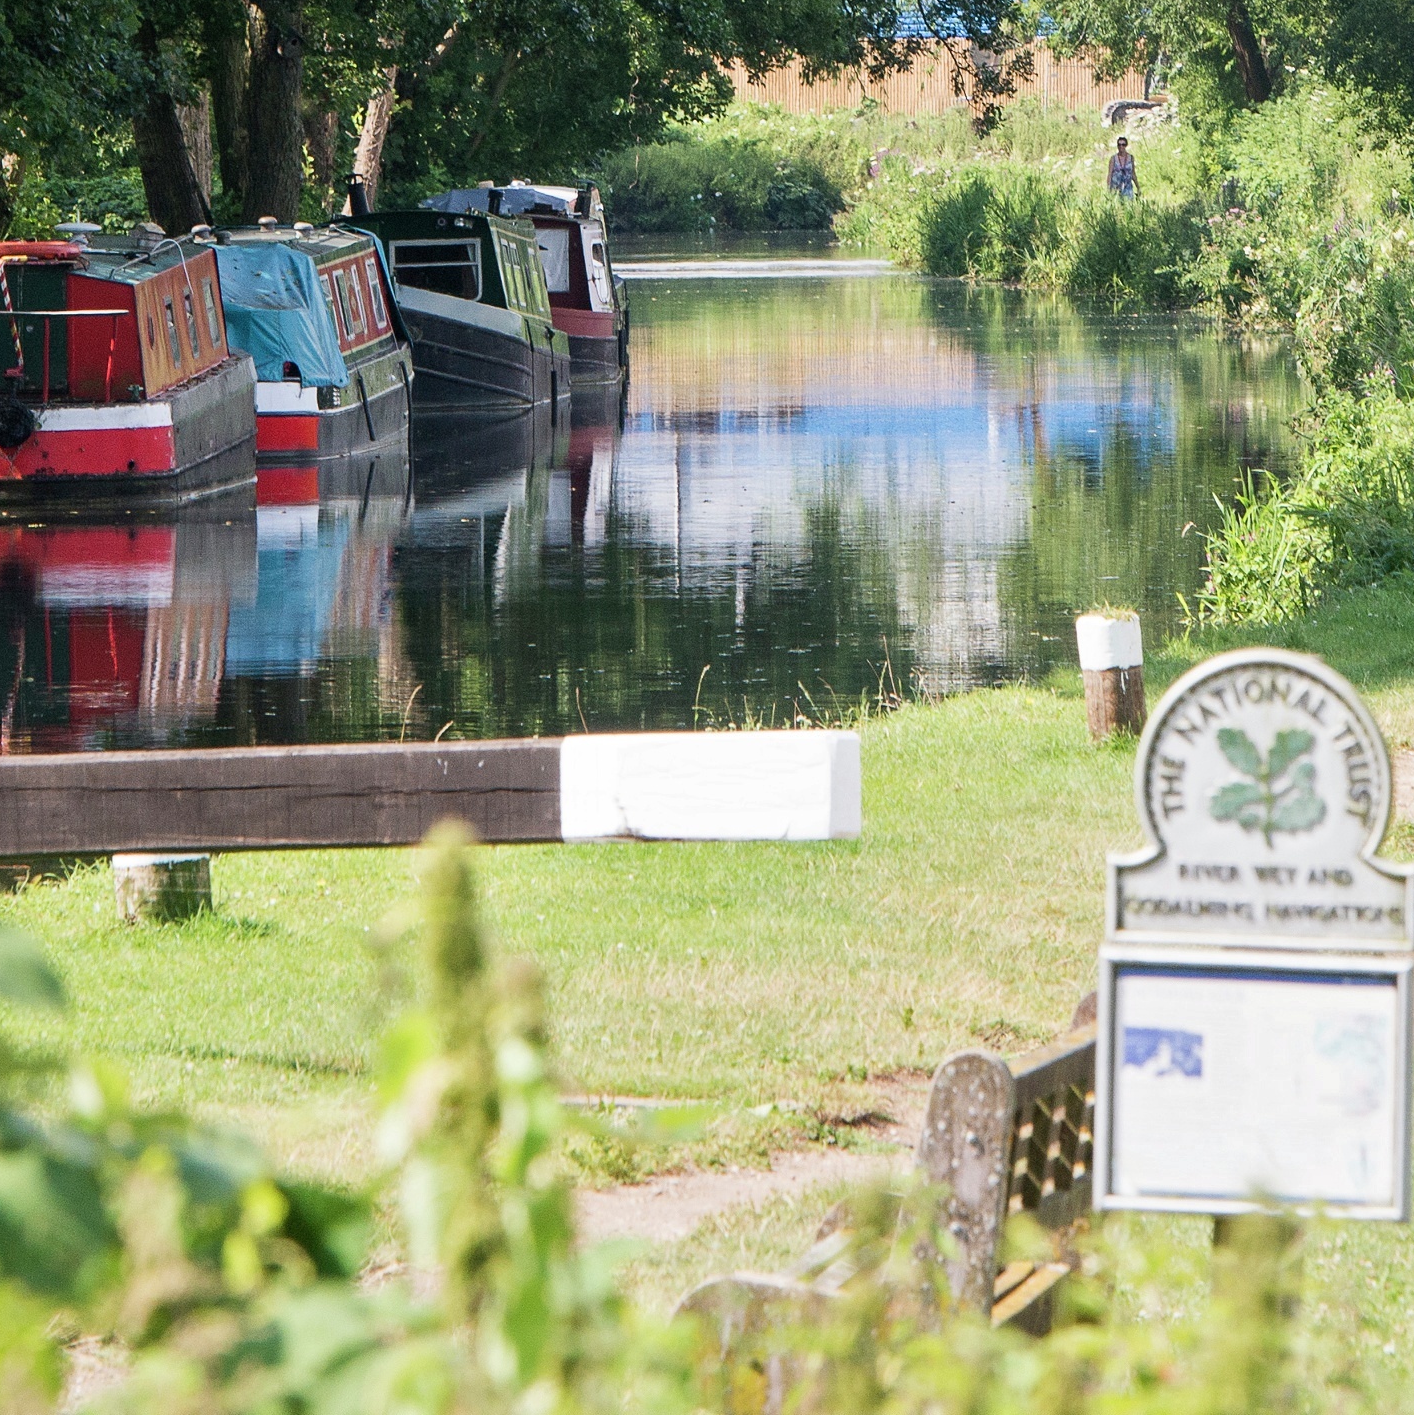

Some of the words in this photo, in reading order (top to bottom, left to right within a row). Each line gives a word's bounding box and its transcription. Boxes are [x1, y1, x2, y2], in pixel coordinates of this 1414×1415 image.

[1160, 757, 1186, 819] THE
[1176, 679, 1328, 745] NATIONAL
[1334, 723, 1373, 828] TRUST
[1308, 868, 1354, 887] AND
